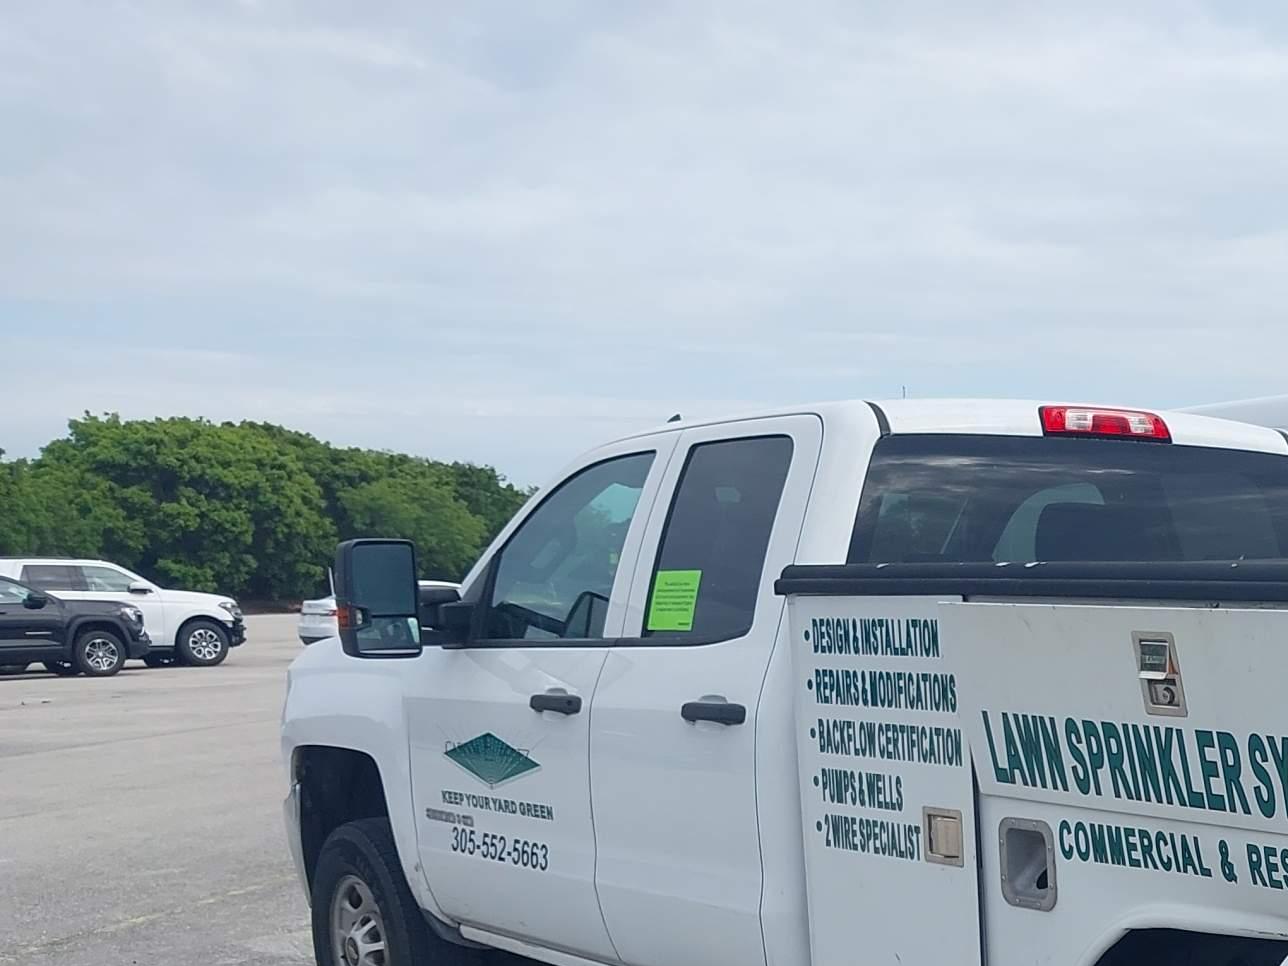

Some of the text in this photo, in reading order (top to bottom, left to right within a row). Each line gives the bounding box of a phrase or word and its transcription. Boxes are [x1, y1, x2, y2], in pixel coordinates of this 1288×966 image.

[812, 618, 940, 658] DESIGN & INSTALLATION
[815, 668, 957, 713] REPAIRS & MODIFICATIONS
[818, 718, 963, 767] BACKFLOW CERTIFICATION
[982, 710, 1069, 792] LAWN
[1065, 717, 1251, 816] SPRINKLER
[442, 789, 554, 820] KEEP YOUR YARD GREEN
[821, 768, 904, 813] PUMPS & WELLS
[451, 826, 550, 872] 305-552-5663
[824, 813, 921, 862] 2 WIRE SPECIALIST
[1059, 819, 1212, 878] COMMERCIAL
[1218, 839, 1238, 884] &
